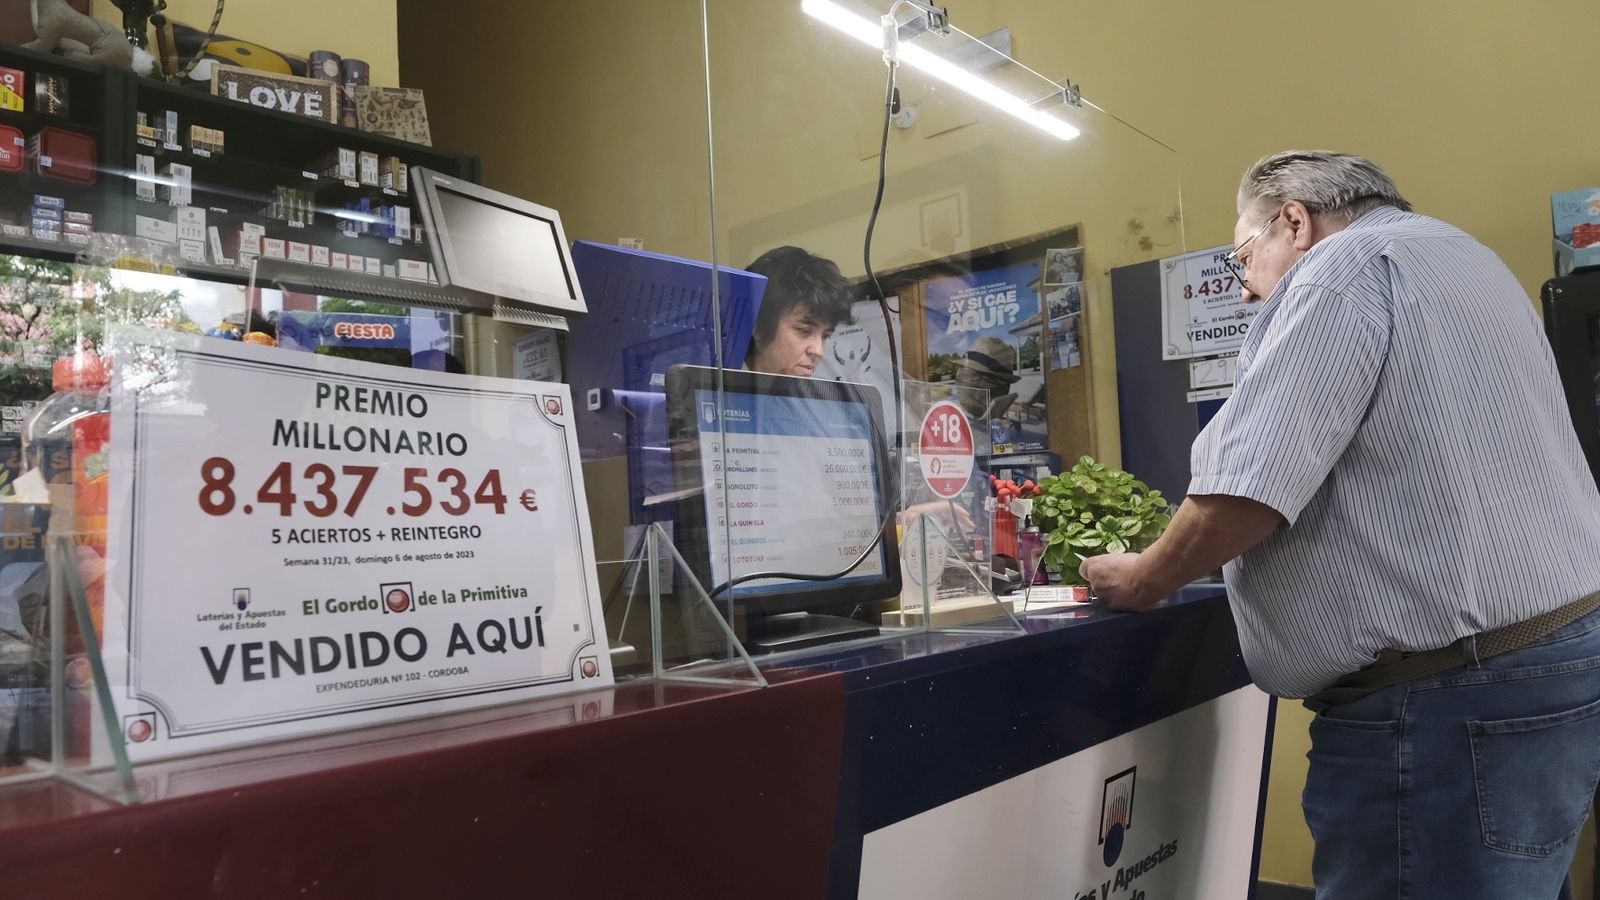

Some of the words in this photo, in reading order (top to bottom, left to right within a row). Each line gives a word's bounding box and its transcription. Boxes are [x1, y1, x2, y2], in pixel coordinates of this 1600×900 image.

[226, 81, 322, 117] LOVE
[947, 300, 965, 314] ¿Y
[967, 296, 982, 310] SI
[984, 289, 1017, 307] CAE
[1207, 294, 1233, 303] ACIERTOS
[335, 322, 395, 340] FIESTA
[946, 303, 1021, 334] AQUÍ?
[1186, 323, 1249, 342] VENDIDO
[316, 382, 428, 418] PREMIO
[717, 408, 750, 418] OTERÍAS
[272, 419, 467, 456] MILLONARIO
[931, 413, 961, 443] +18
[198, 457, 508, 517] 8.437.534
[518, 488, 538, 512] €
[272, 528, 282, 544] 5
[287, 527, 371, 544] ACIERTOS
[376, 530, 386, 541] +
[391, 525, 482, 542] REINTEGRO
[283, 557, 319, 567] Semana
[322, 555, 351, 566] 31/23,
[355, 554, 393, 564] domingo
[395, 554, 400, 562] 6
[402, 553, 413, 562] de
[415, 552, 442, 562] agosto
[444, 551, 454, 559] de
[455, 550, 475, 559] 2023
[237, 612, 242, 621] y
[245, 609, 286, 619] Apuestas
[302, 598, 320, 616] El
[325, 594, 378, 614] Gordo
[418, 590, 437, 606] de
[441, 589, 456, 605] la
[460, 585, 528, 603] Primitiva
[219, 621, 233, 631] del
[235, 620, 266, 630] Estado
[199, 626, 428, 686] VENDIDO
[445, 605, 545, 658] AQUÍ
[315, 676, 389, 694] EXPENDEDURIA
[406, 671, 421, 682] 102
[428, 665, 469, 679] CORDOBA
[1102, 880, 1111, 900] y
[1112, 839, 1179, 893] Apuestas
